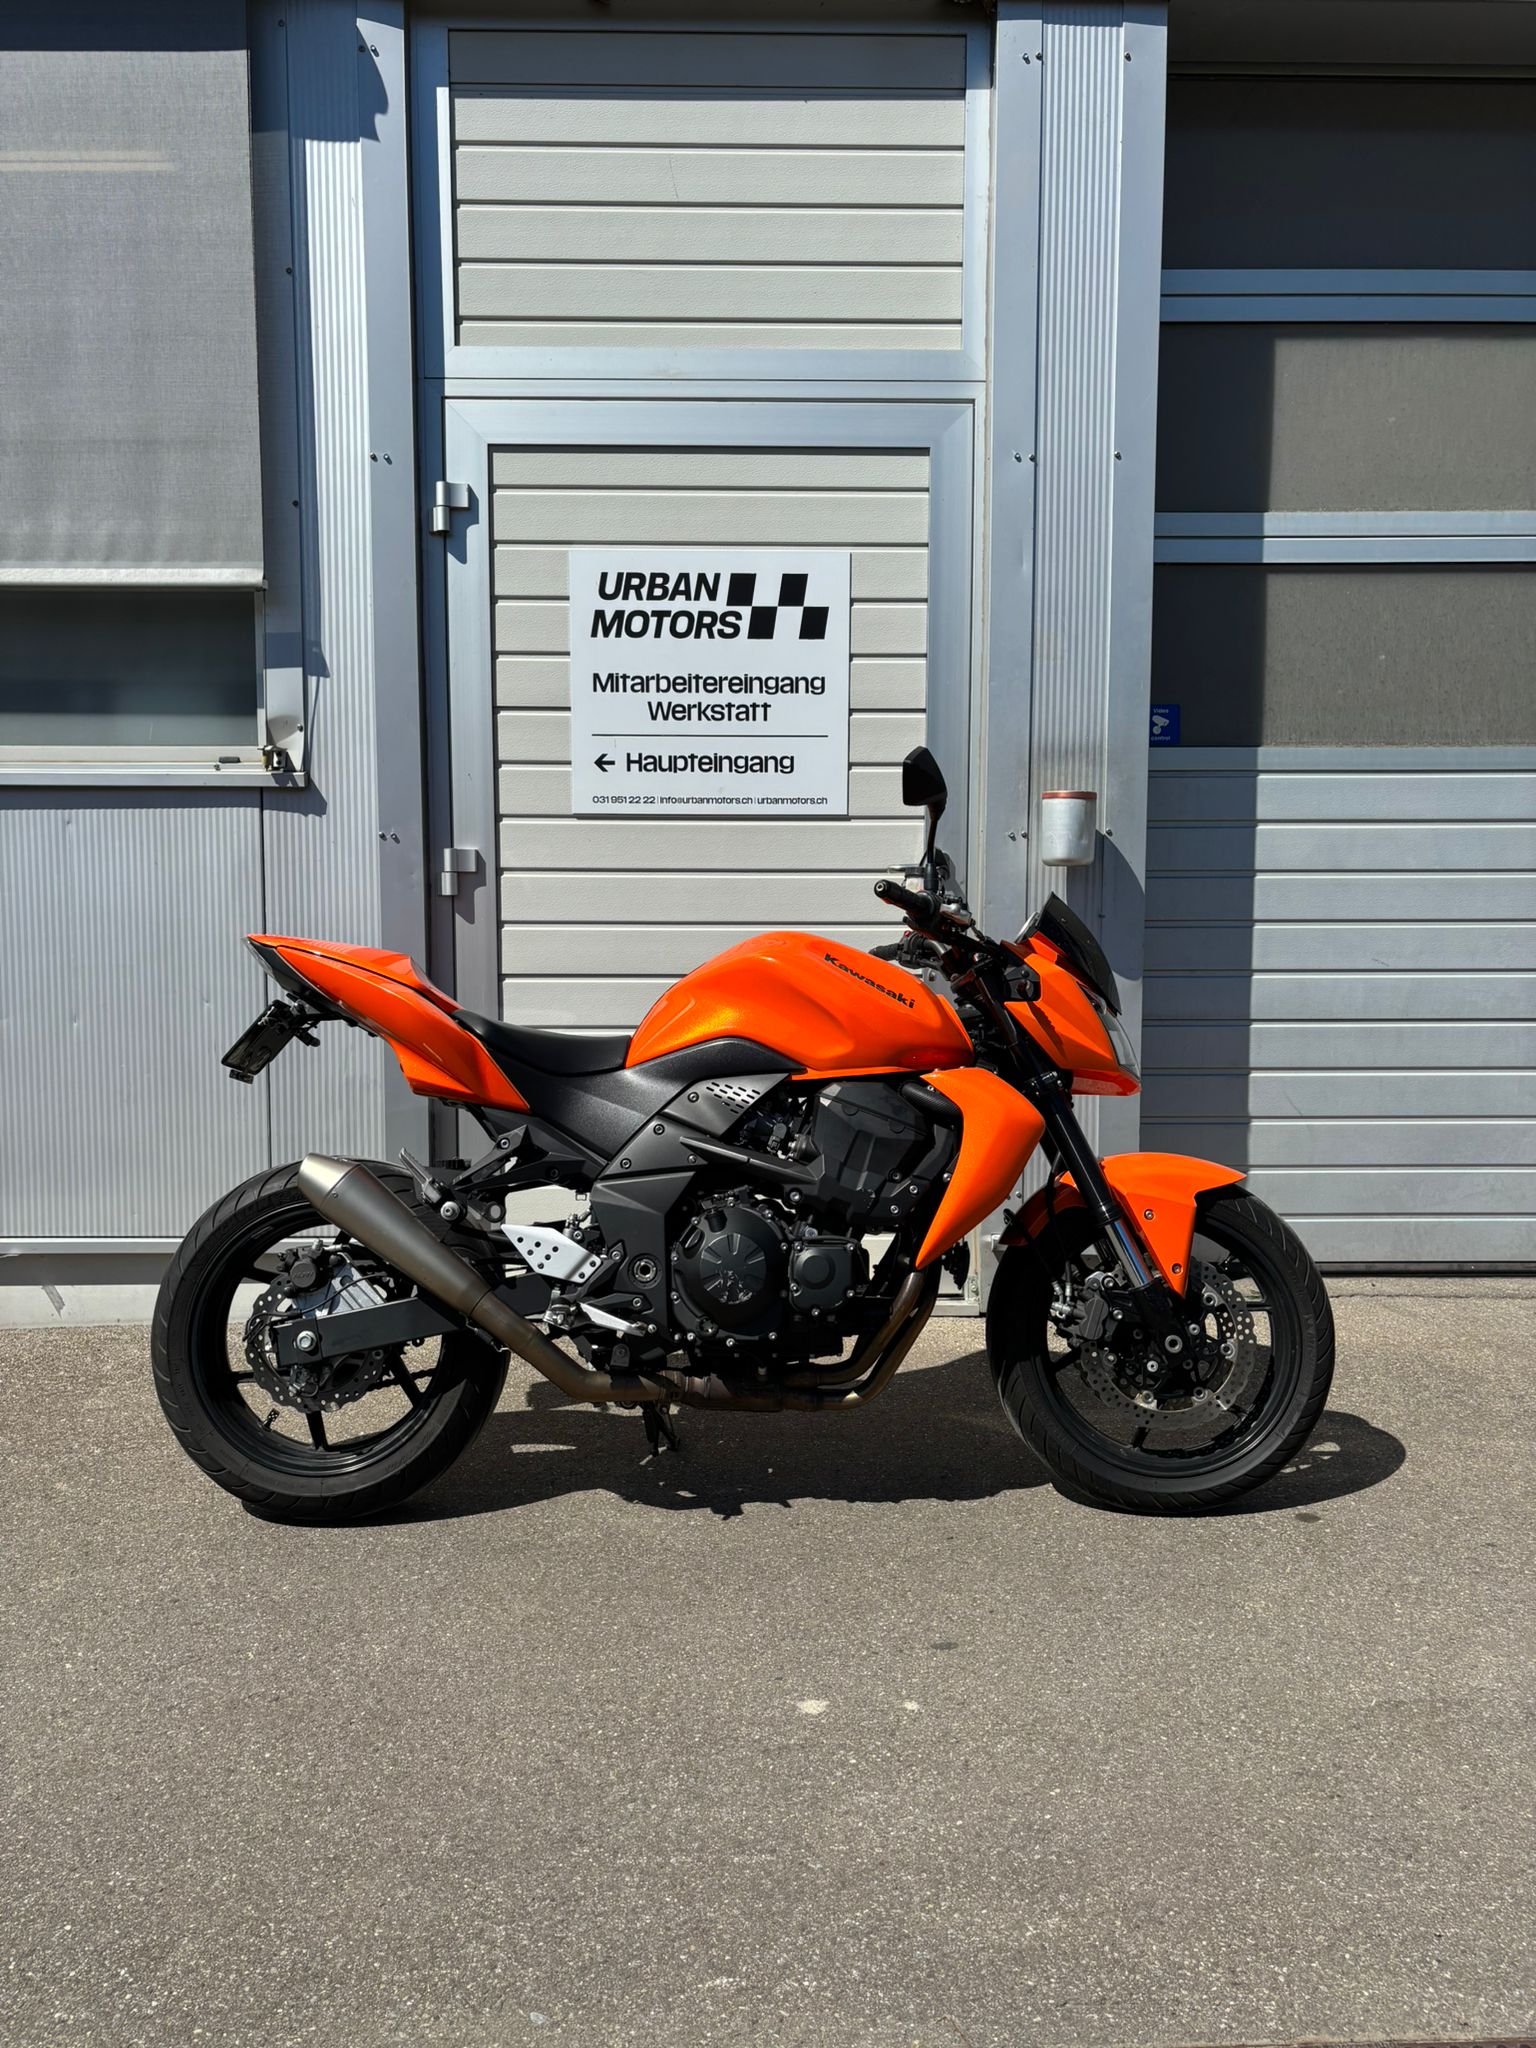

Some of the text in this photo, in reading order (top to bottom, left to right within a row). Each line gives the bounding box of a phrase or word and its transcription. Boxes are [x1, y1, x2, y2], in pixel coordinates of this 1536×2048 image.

[598, 571, 721, 602] URBAN
[590, 609, 743, 640] MOTORS
[592, 672, 826, 696] Mitarbeitereingang
[647, 701, 772, 722] Werkstatt
[626, 752, 795, 775] Haupteingang
[642, 795, 656, 804] 22
[756, 796, 828, 805] urbanmotors.ch
[824, 953, 916, 1009] Kawasaki
